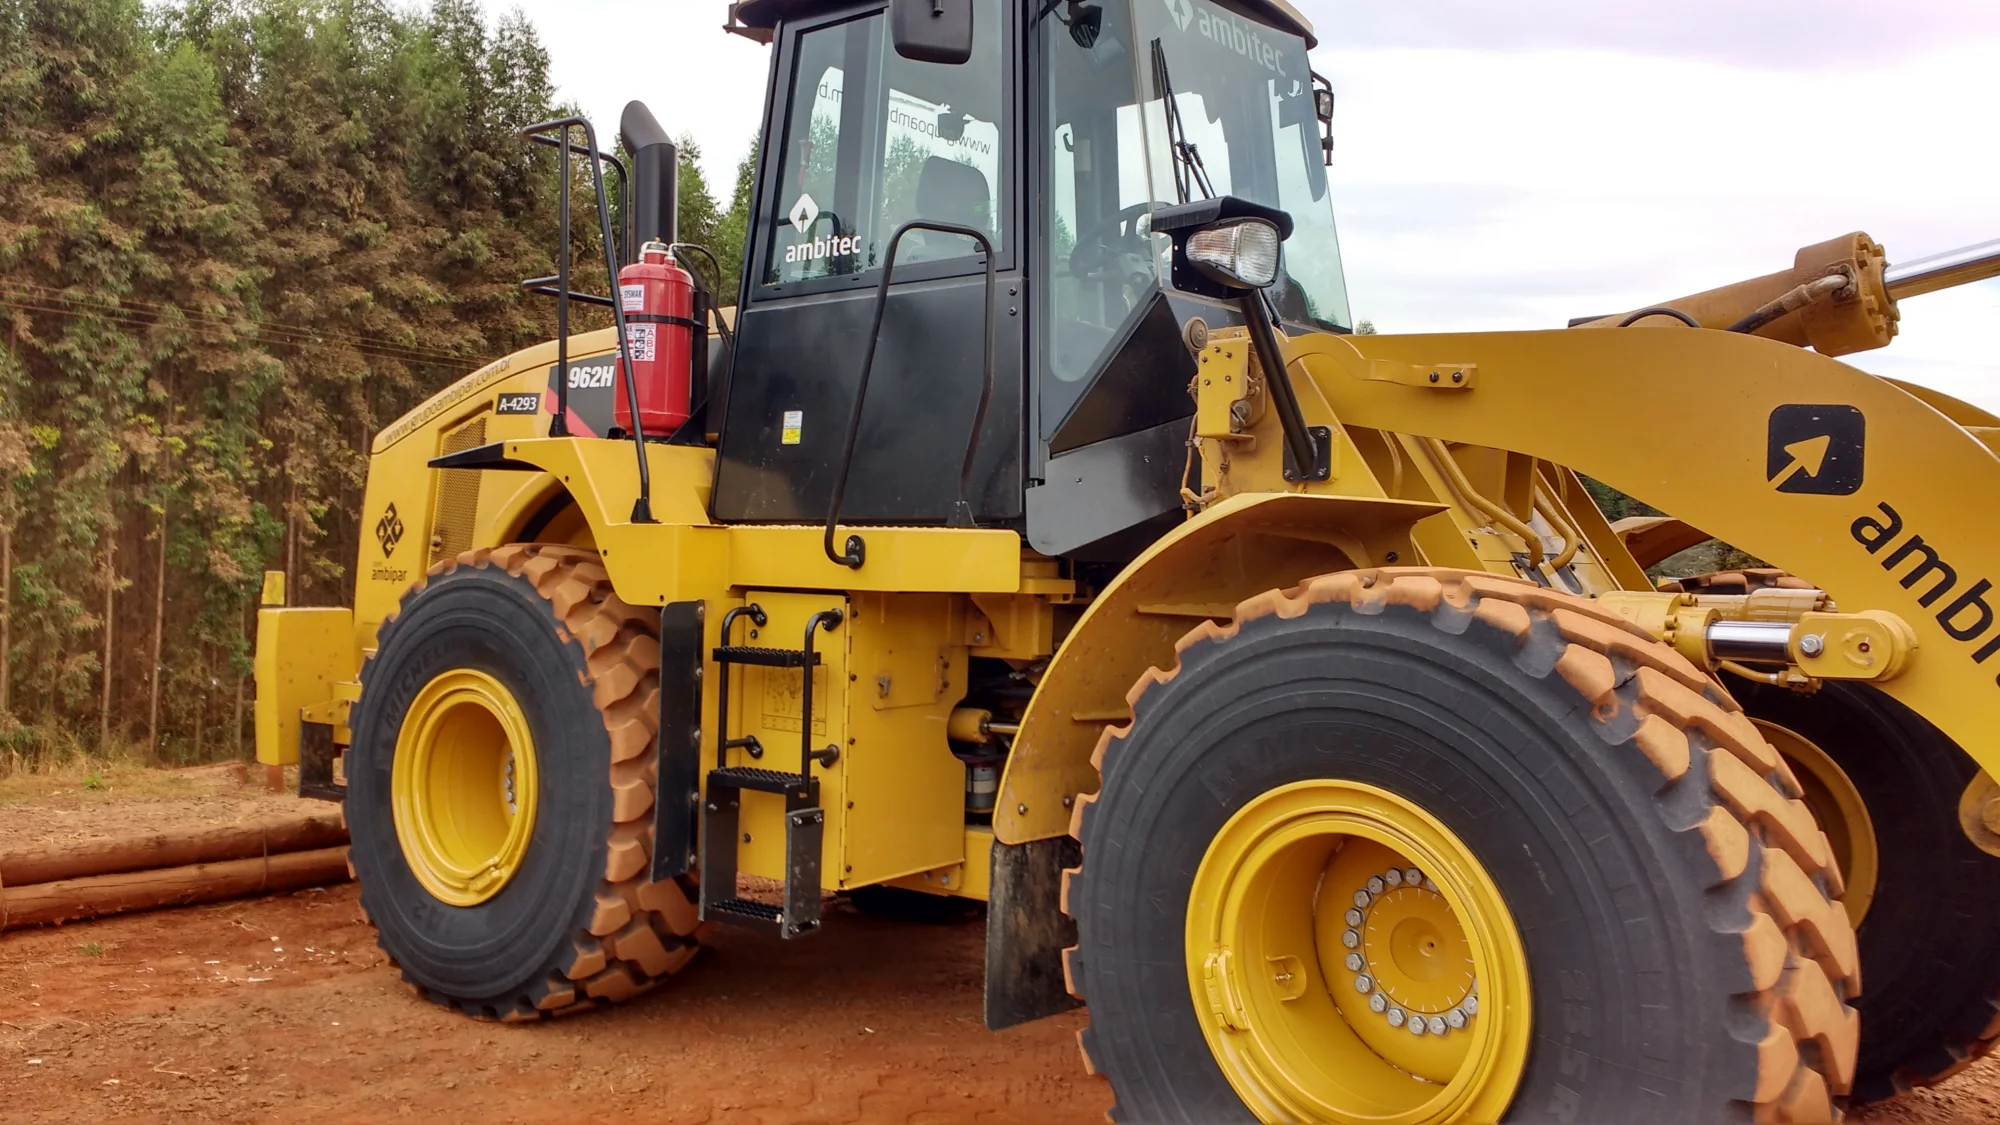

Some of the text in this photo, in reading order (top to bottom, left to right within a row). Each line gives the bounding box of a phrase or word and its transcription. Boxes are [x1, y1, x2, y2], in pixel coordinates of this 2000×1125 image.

[1197, 5, 1288, 77] ambitec
[785, 234, 861, 263] ambitec
[568, 365, 615, 389] 962H
[498, 396, 538, 411] A-4293
[372, 566, 408, 585] ambipar
[1850, 501, 2000, 688] ambi
